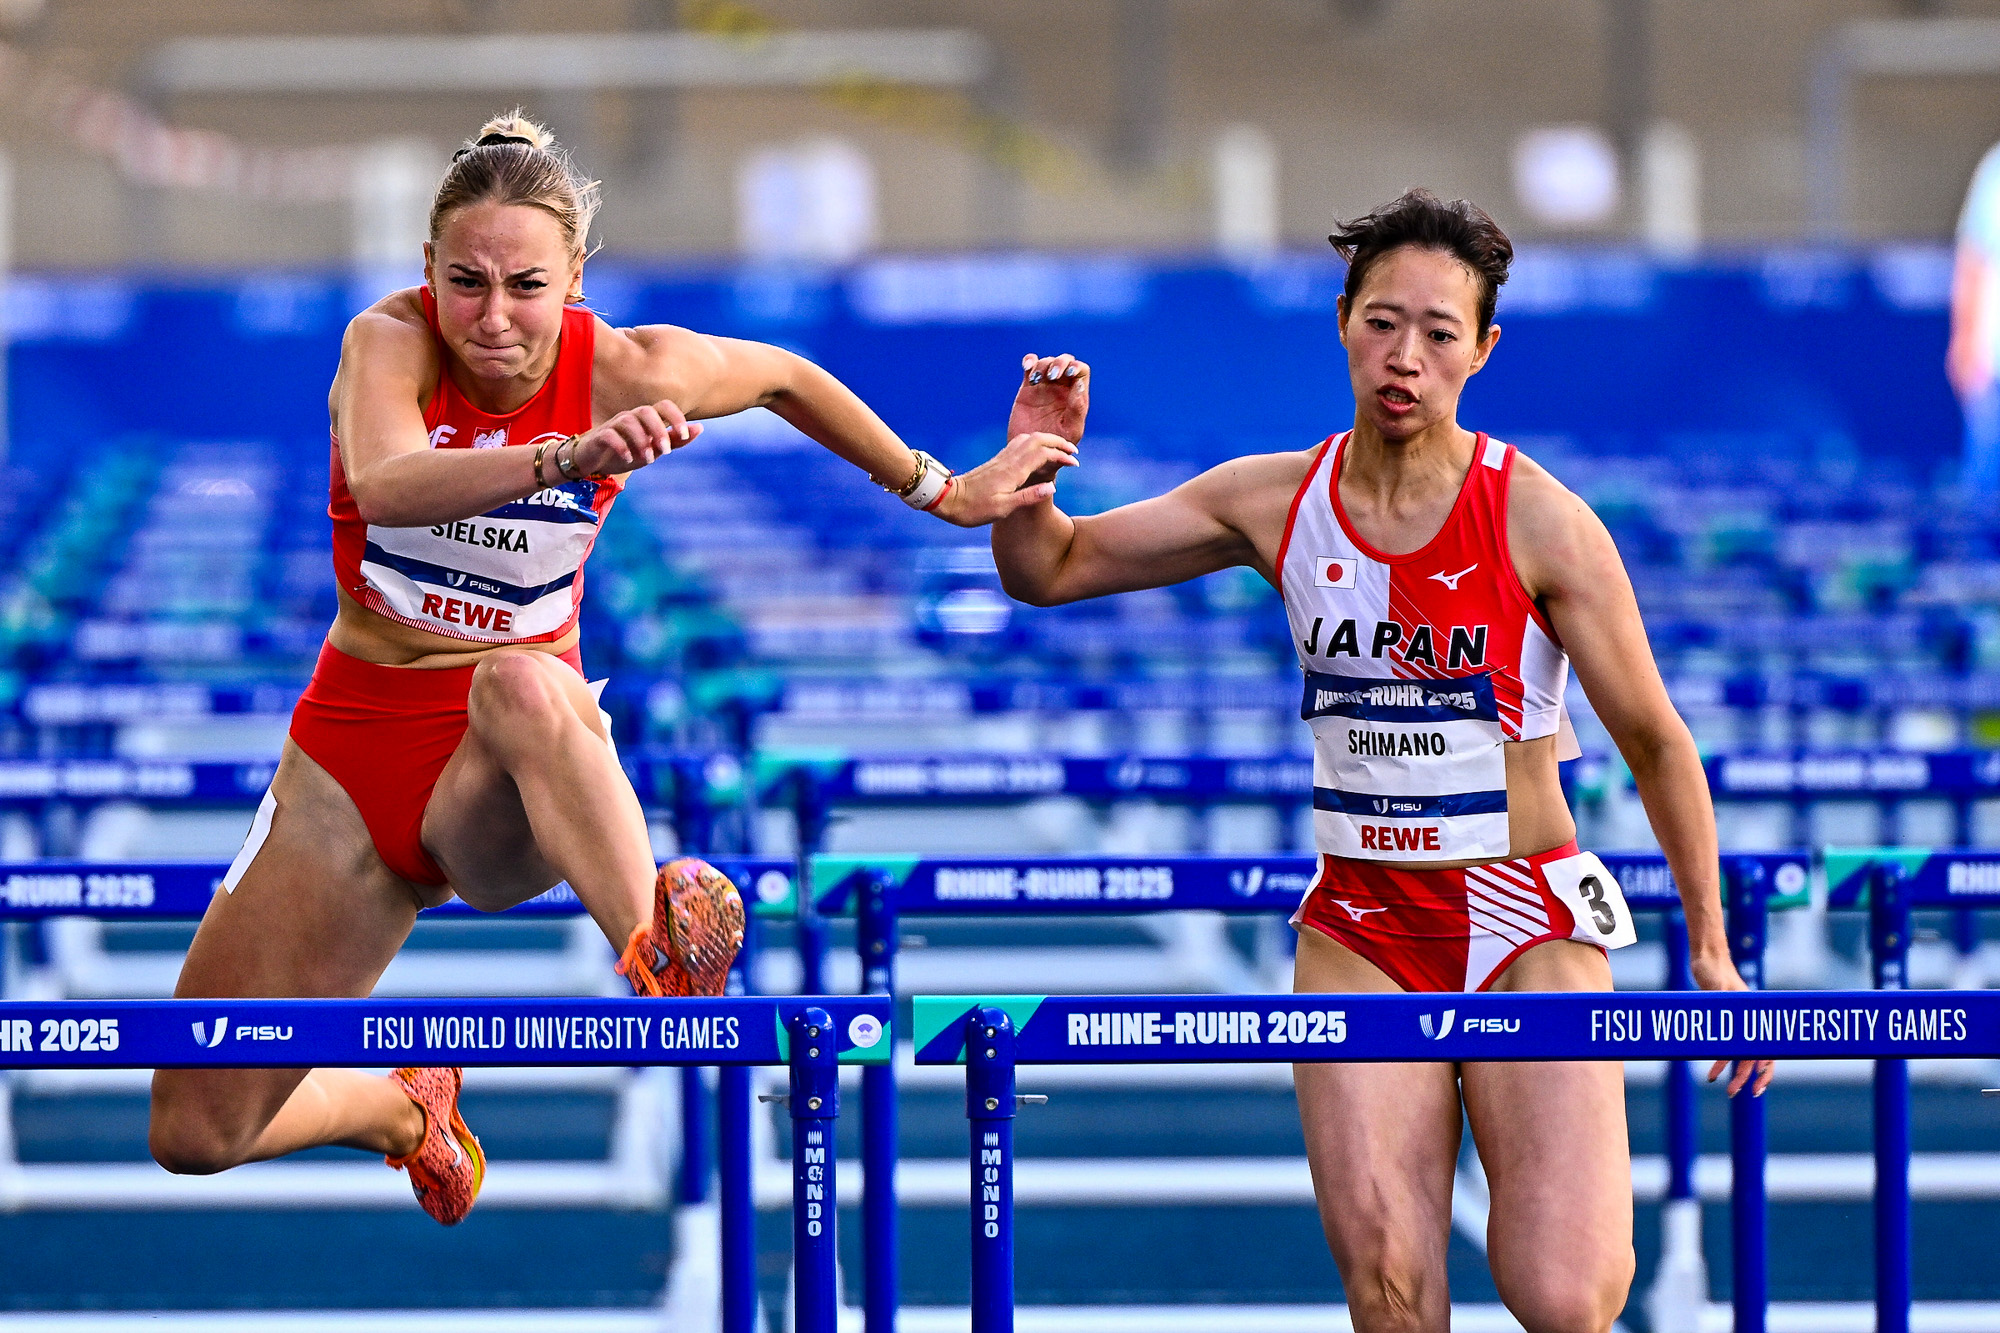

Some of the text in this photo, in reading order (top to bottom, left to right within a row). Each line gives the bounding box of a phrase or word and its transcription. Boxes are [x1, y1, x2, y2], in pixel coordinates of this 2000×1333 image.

[528, 488, 579, 510] 2025
[431, 521, 529, 553] SIELSKA
[469, 580, 501, 594] FISU
[421, 593, 513, 632] REWE
[1304, 617, 1488, 669] JAPAN
[1427, 690, 1477, 710] 2025
[1348, 729, 1446, 757] SHIMANO
[1391, 803, 1422, 812] FISU
[1361, 825, 1441, 851] REWE
[1103, 867, 1174, 900] 2025
[1579, 874, 1616, 935] 3
[40, 1018, 120, 1051] 2025
[236, 1026, 293, 1041] FISU
[363, 1016, 739, 1050] FISU WORLD UNIVERSITY GAMES
[1067, 1010, 1347, 1046] RHINE-RUHR 2025
[1463, 1018, 1521, 1033] FISU
[1591, 1008, 1967, 1042] FISU WORLD UNIVERSITY GAMES
[805, 1147, 825, 1237] MONDO
[981, 1149, 1002, 1238] MONDO
